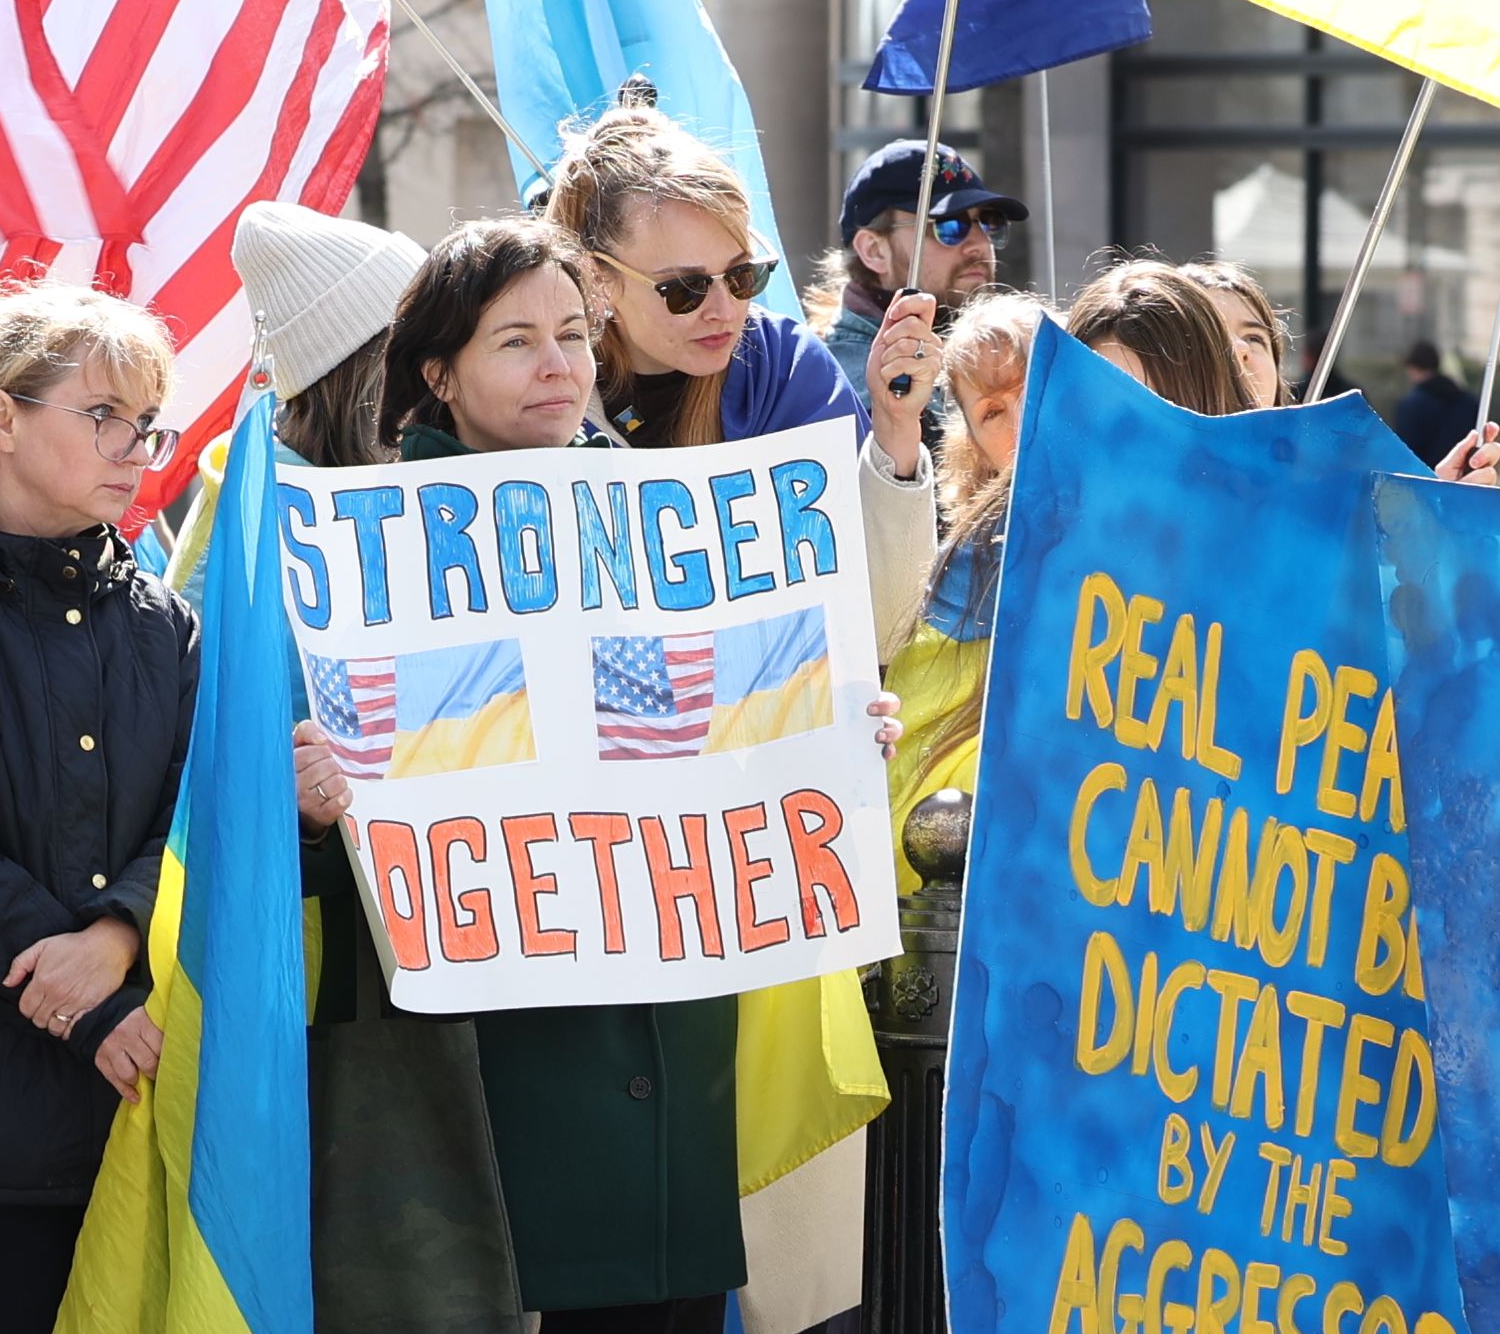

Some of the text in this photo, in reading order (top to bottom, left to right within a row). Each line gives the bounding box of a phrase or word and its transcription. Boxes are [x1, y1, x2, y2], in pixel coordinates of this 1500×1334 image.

[277, 459, 838, 631] STRONGER
[1066, 571, 1244, 781] REAL
[344, 788, 860, 972] OGETHER
[1068, 762, 1357, 969] CANNOT
[1075, 930, 1439, 1169] DICTATED
[1157, 1112, 1357, 1257] BY THE
